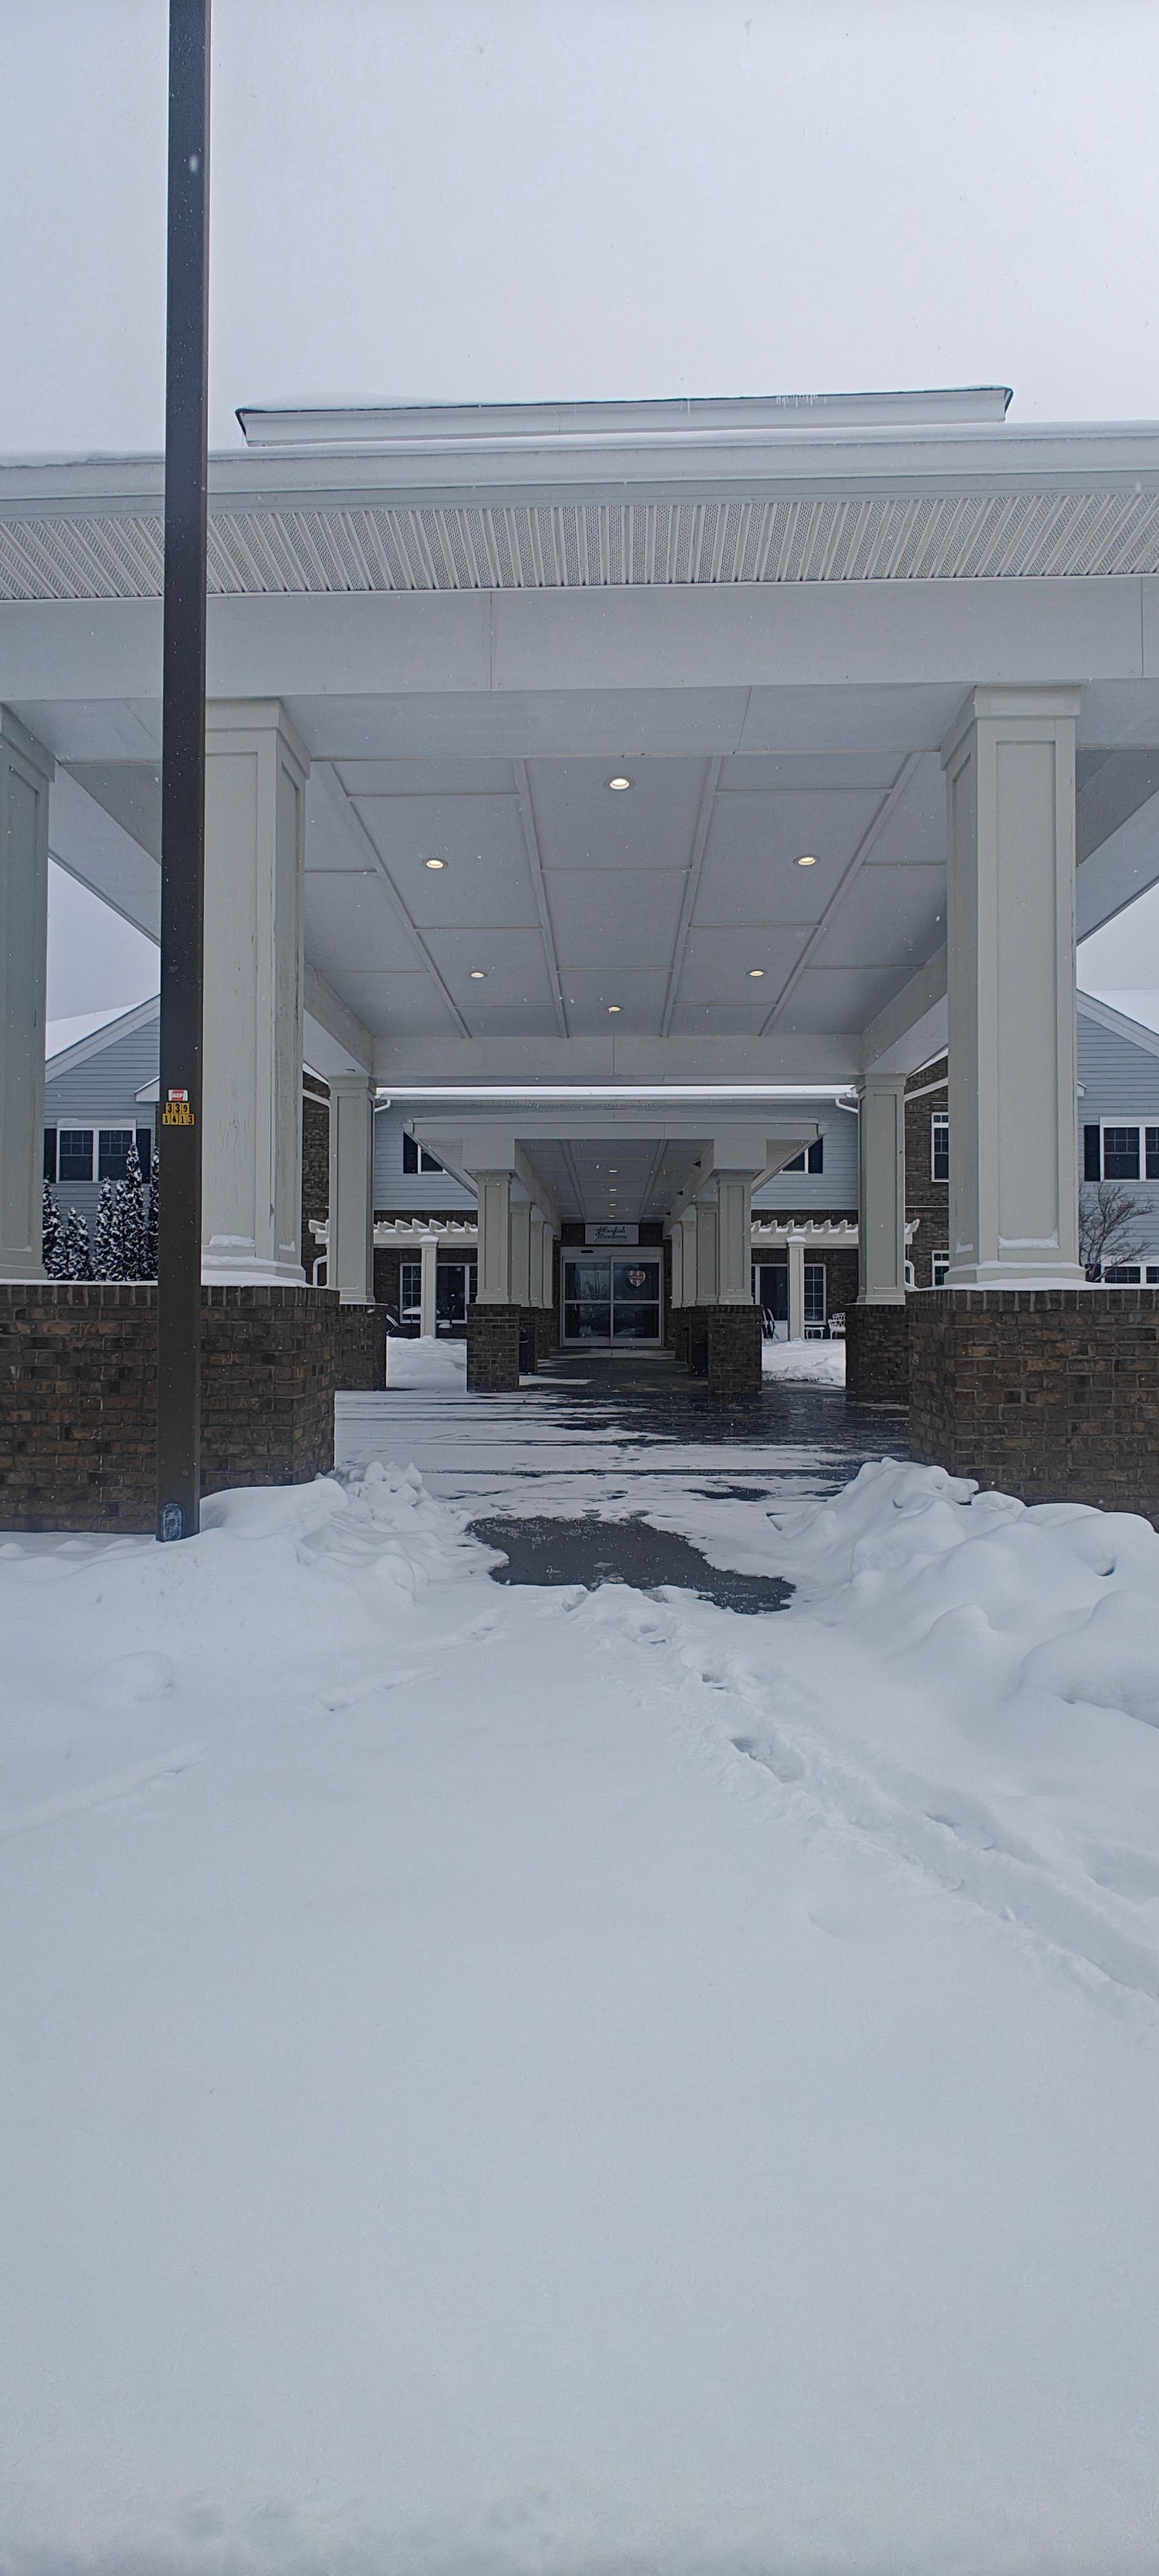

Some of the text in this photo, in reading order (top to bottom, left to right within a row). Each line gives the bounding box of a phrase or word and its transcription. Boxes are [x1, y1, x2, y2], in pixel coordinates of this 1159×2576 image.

[167, 1104, 187, 1113] 339
[165, 1115, 193, 1124] 1413
[604, 1226, 626, 1235] English
